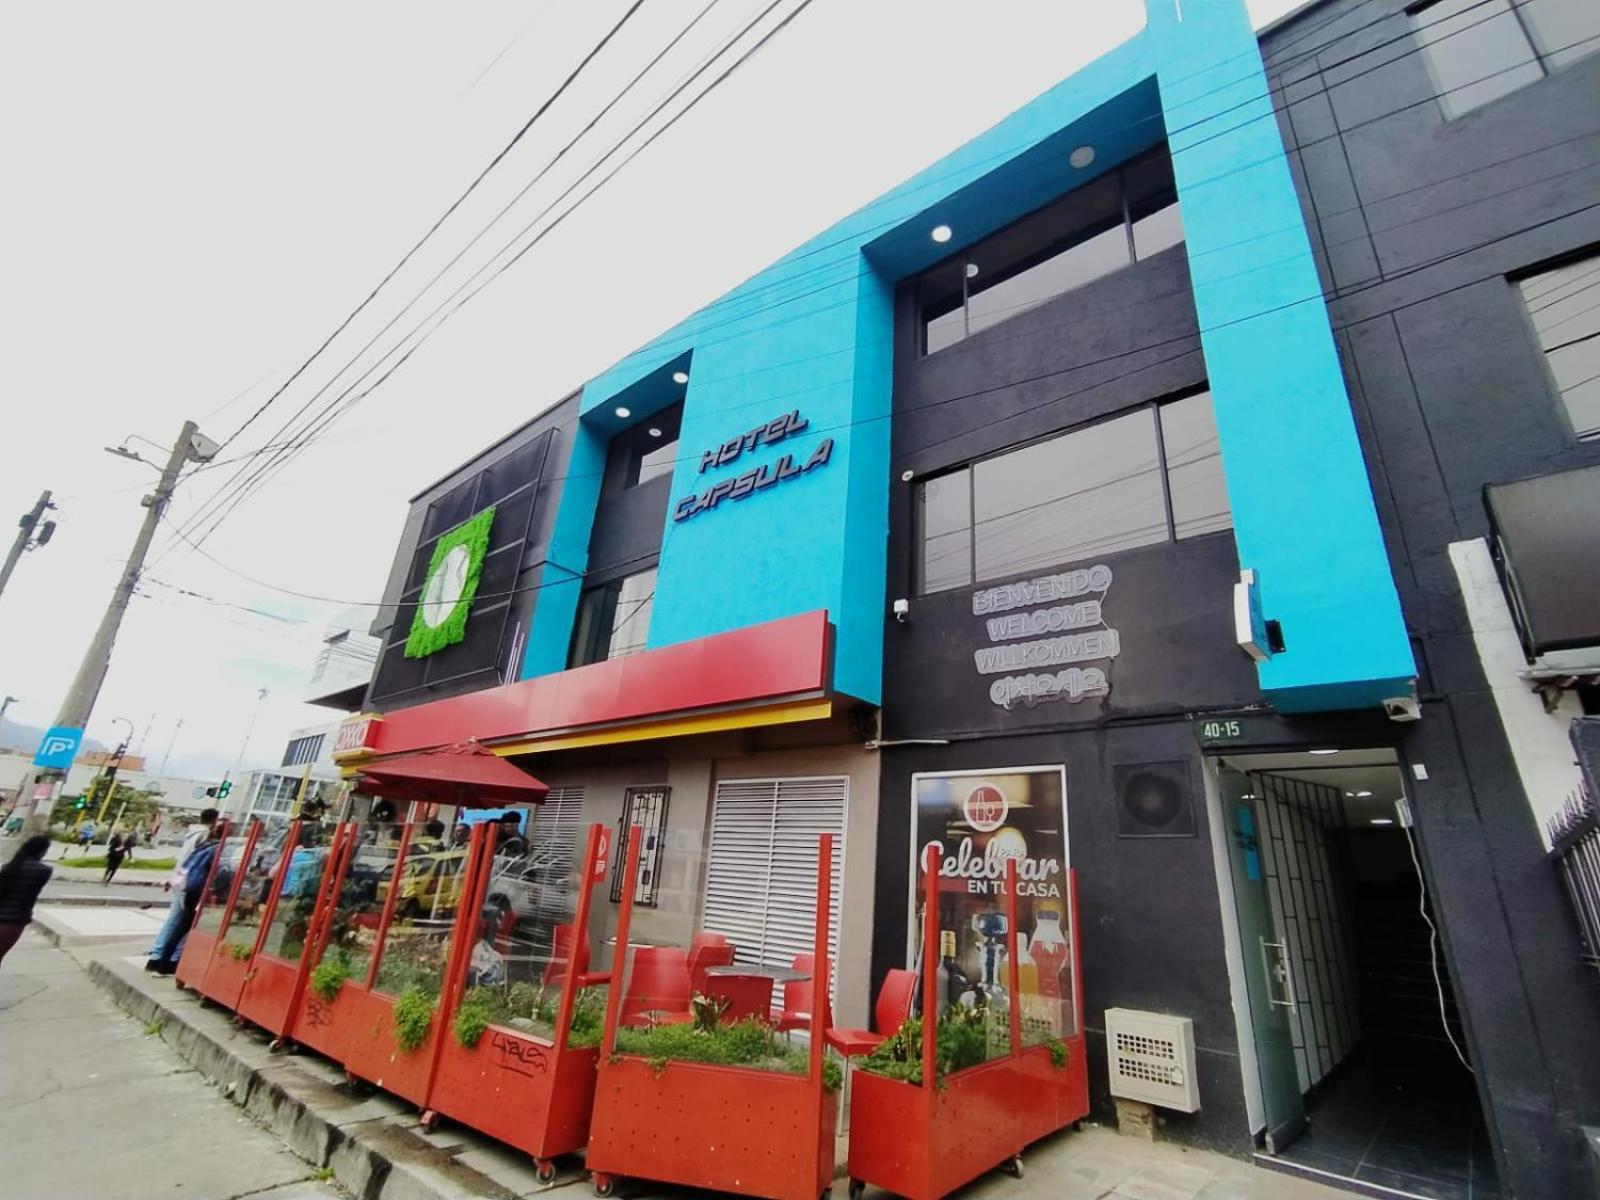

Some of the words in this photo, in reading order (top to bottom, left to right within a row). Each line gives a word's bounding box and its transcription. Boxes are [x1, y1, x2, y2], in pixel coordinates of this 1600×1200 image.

[698, 408, 809, 473] HOTEL
[674, 437, 835, 522] CAPSULA
[974, 566, 1110, 614] BIENVENIDO
[988, 602, 1100, 639] WELCOME
[976, 631, 1119, 672] WILLKOMMEN
[1204, 721, 1240, 738] 40-15
[967, 879, 988, 894] EN
[1015, 882, 1061, 898] CASA
